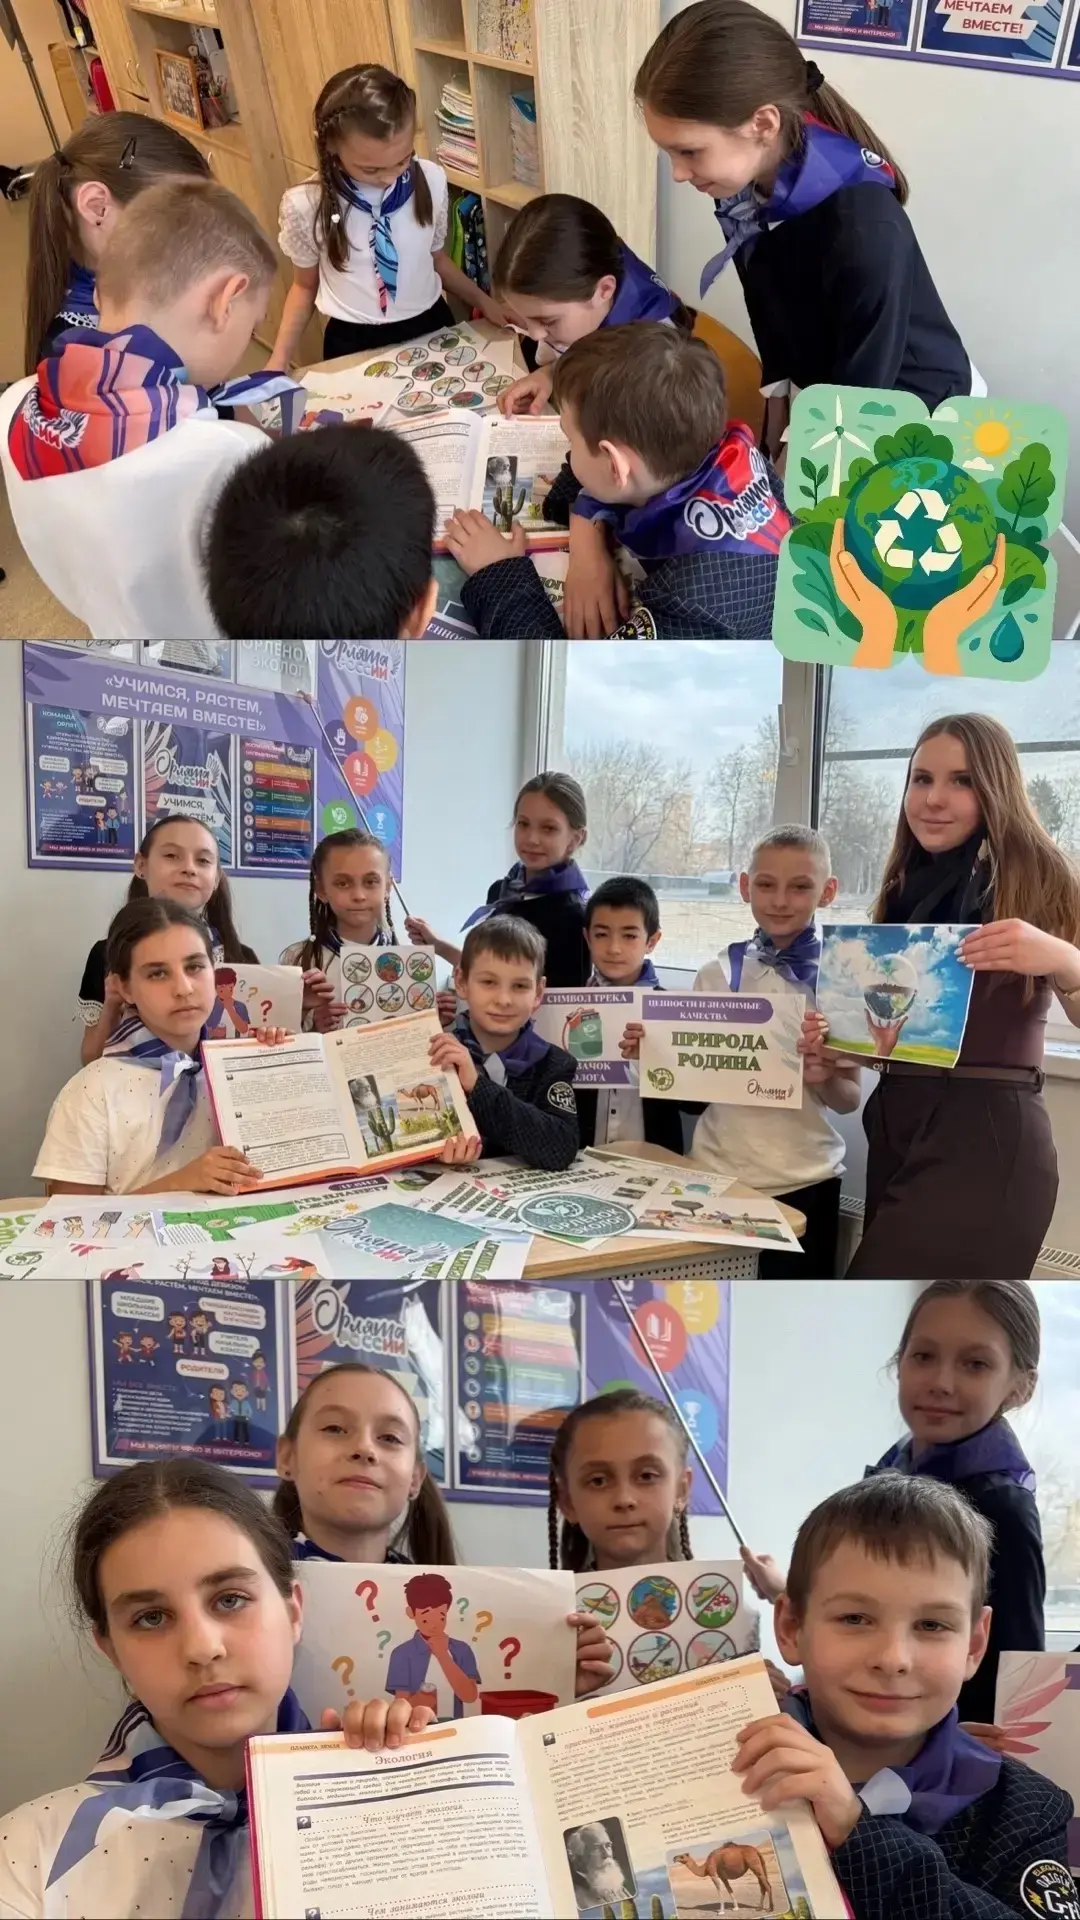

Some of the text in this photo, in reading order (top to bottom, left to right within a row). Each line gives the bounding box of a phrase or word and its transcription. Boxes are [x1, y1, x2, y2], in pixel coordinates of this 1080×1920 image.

[944, 0, 1012, 15] МЕЧТАЕМ
[962, 18, 1023, 34] ВМЕСТЕ!
[105, 674, 263, 716] «УЧИМСЯ, РАСТЕМ,
[102, 694, 266, 732] МЕЧТАЕМ ВМЕСТЕ!»
[156, 749, 210, 778] Орлята
[163, 797, 205, 811] УЧИМСЯ,
[547, 993, 627, 1004] СИМВОЛ ТРЕКА
[648, 999, 697, 1009] ЦЕННОСТИ
[707, 1001, 761, 1011] ЗНАЧИМЫЕ
[680, 1012, 728, 1022] КАЧЕСТВА
[671, 1031, 769, 1052] ПРИРОДА
[677, 1052, 762, 1072] РОДИНА
[315, 1290, 405, 1339] Орлята
[375, 1750, 432, 1765] Экология
[363, 1815, 382, 1823] Что
[426, 1805, 462, 1814] экология
[368, 1908, 386, 1916] Чем
[390, 1899, 448, 1913] занимаются
[452, 1892, 484, 1902] экологи
